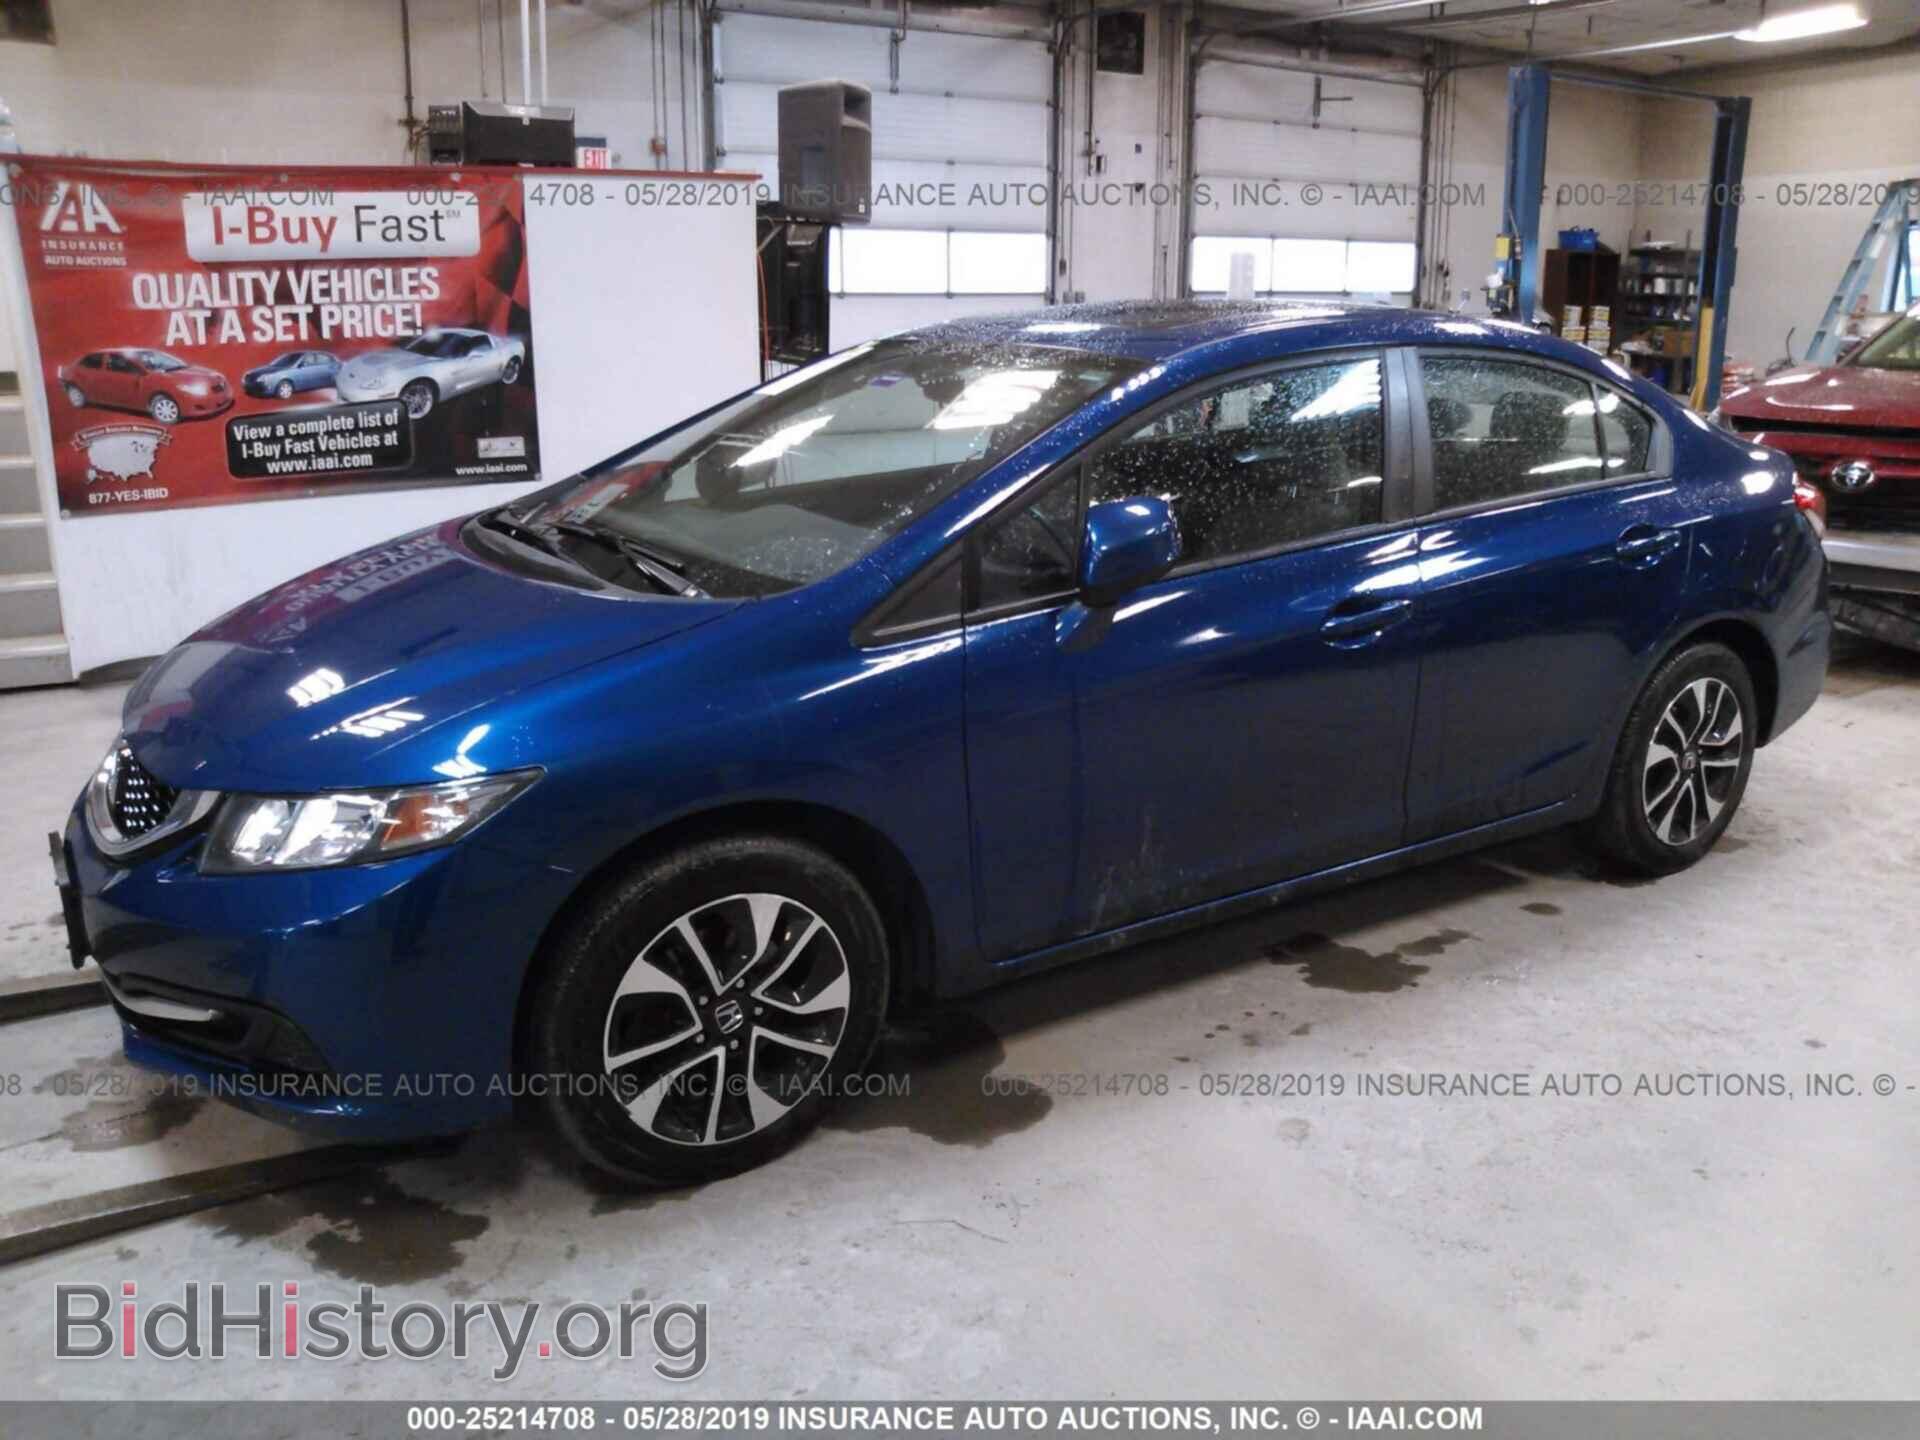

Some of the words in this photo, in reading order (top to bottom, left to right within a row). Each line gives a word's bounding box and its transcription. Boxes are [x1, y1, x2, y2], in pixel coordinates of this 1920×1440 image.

[583, 149, 608, 169] EXIT
[211, 204, 338, 253] I-Buy
[353, 204, 447, 243] Fast
[41, 239, 125, 252] INSURANCE
[44, 255, 73, 266] AUTO
[75, 255, 127, 267] AUCTIONS
[132, 270, 281, 310] QUALITY
[287, 266, 440, 306] VEHICLES
[165, 309, 213, 347] AT
[220, 308, 247, 344] A
[252, 305, 314, 344] SET
[320, 302, 424, 341] PRICE!
[233, 424, 272, 442] View
[276, 425, 285, 436] a
[288, 413, 355, 437] complete
[358, 411, 382, 429] list
[385, 408, 399, 426] of
[241, 440, 282, 460] I-Buy
[284, 437, 316, 457] Fast
[318, 432, 383, 452] Vehicles
[384, 431, 399, 447] at
[266, 451, 374, 475] www.iaai.com
[455, 461, 529, 476] www.iaai.com
[88, 486, 170, 504] 877-YES-IBID
